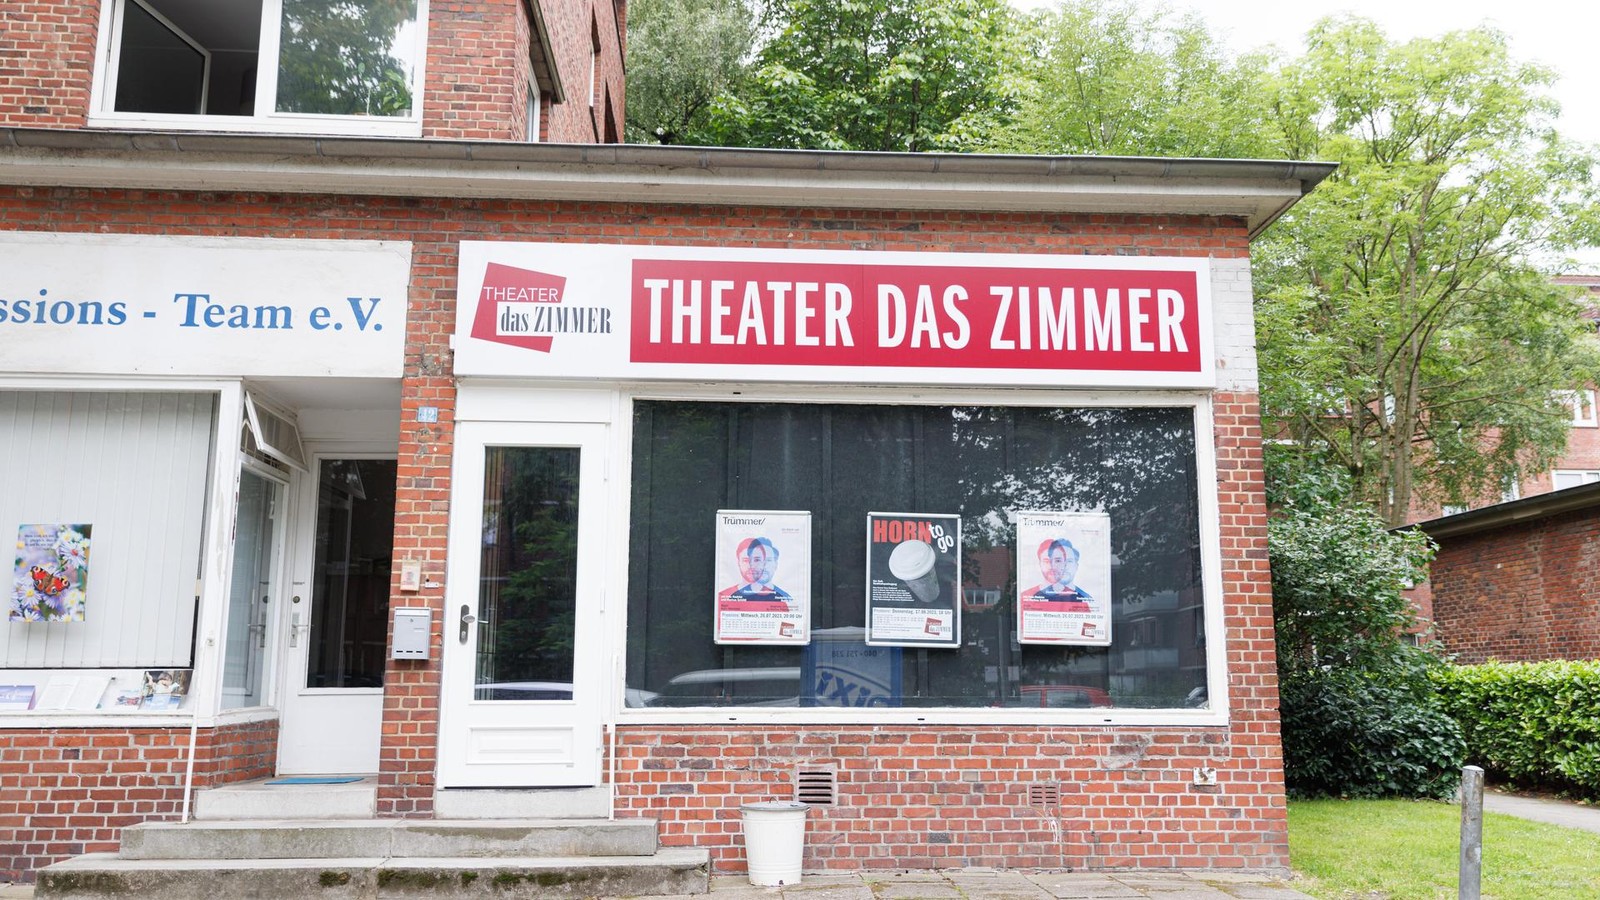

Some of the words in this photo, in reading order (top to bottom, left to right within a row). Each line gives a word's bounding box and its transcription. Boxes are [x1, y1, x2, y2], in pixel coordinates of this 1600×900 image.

[482, 285, 559, 302] THEATER
[173, 292, 294, 329] Team
[308, 296, 383, 331] e.V.
[500, 305, 529, 333] das
[533, 305, 612, 334] ZIMMER
[643, 278, 855, 347] THEATER
[877, 283, 971, 351] DAS
[988, 285, 1190, 353] ZIMMER
[873, 519, 932, 544] HORN
[928, 523, 944, 539] to
[937, 535, 954, 554] go
